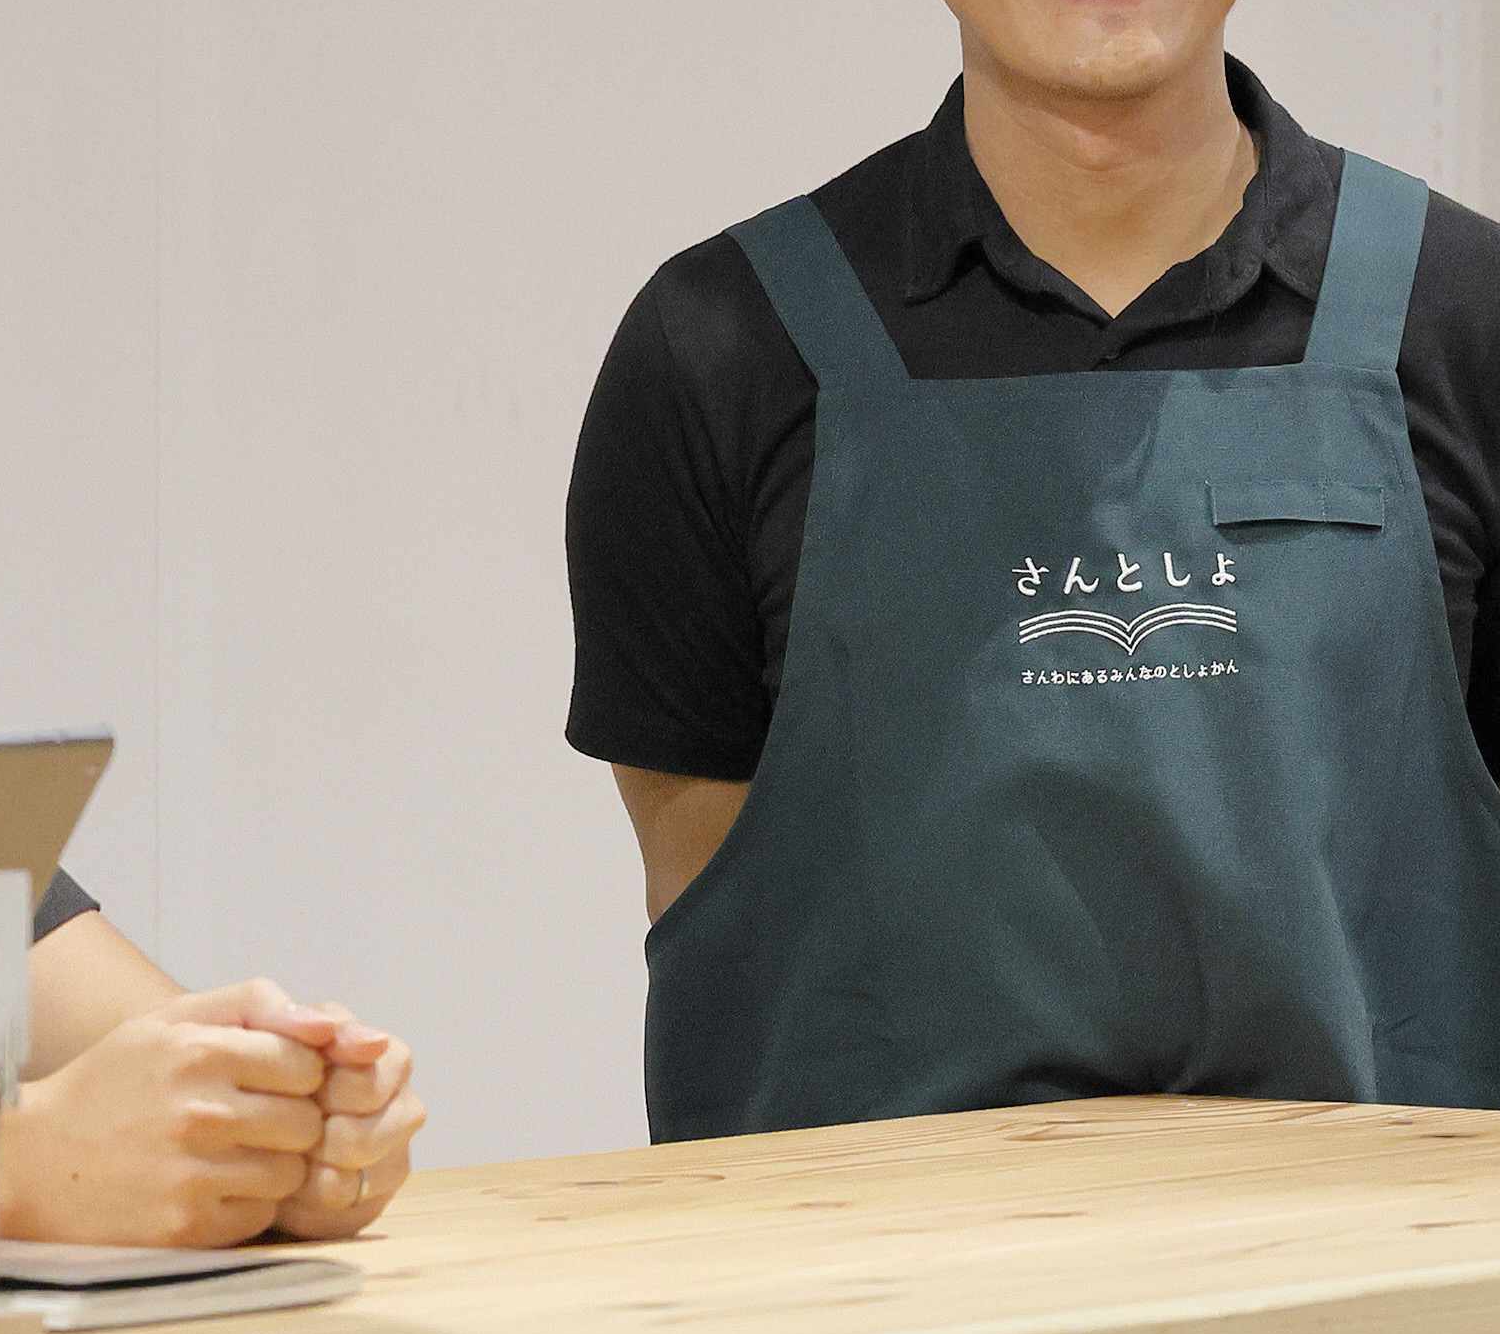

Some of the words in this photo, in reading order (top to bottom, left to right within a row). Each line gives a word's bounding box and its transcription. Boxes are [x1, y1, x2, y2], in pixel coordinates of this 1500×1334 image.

[1011, 552, 1238, 597] さんとしょ
[1020, 659, 1240, 686] さんわにあるみんなのとしょかん
